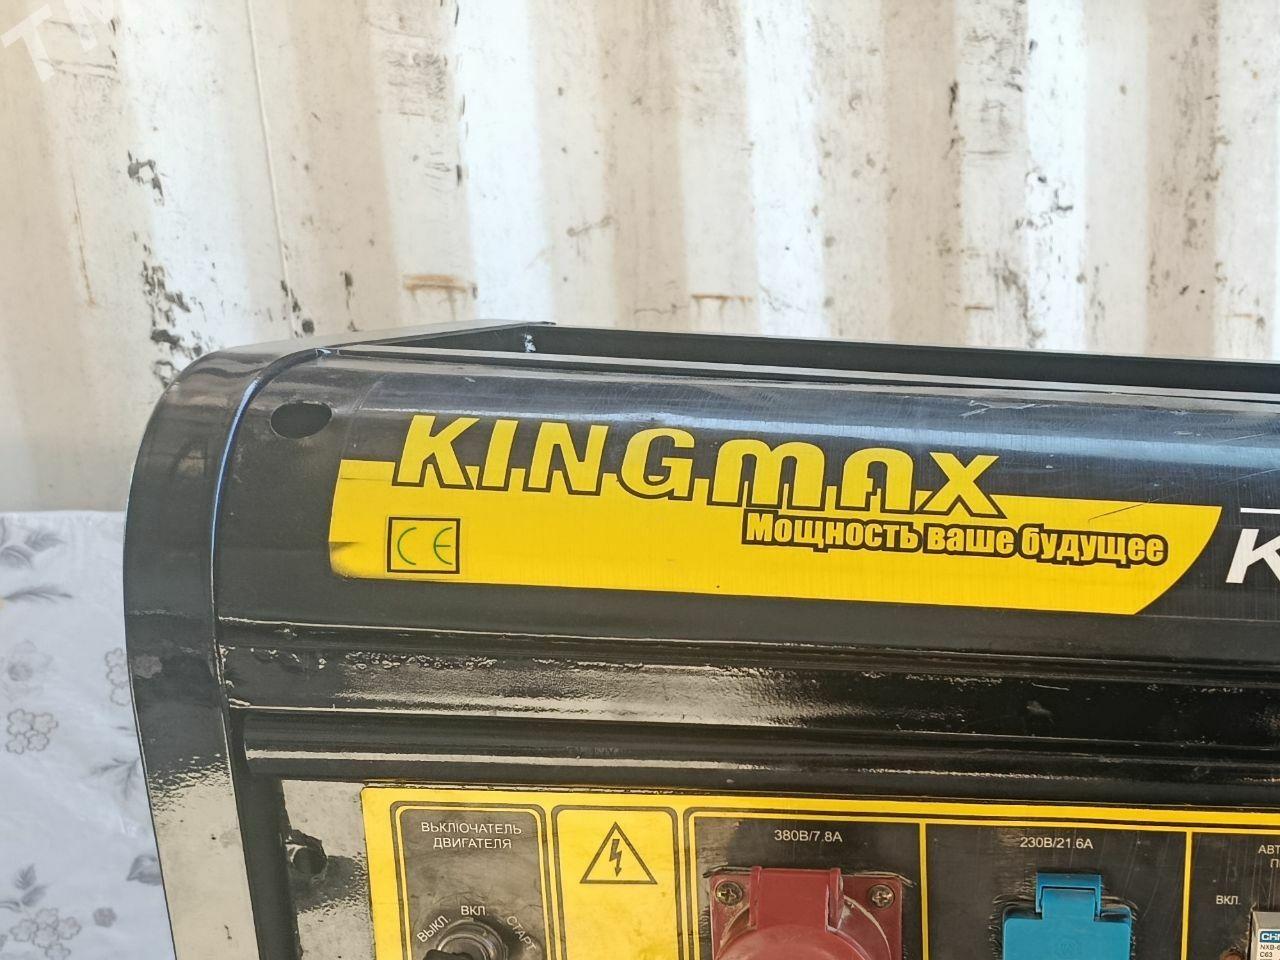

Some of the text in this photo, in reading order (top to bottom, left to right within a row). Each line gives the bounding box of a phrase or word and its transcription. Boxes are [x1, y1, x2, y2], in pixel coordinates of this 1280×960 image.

[745, 512, 1167, 567] Мощность ваше будущее
[432, 837, 513, 850] ДВИГАТЕЛЯ
[1215, 895, 1241, 906] ВКЛ.
[506, 915, 537, 951] СТАРТ
